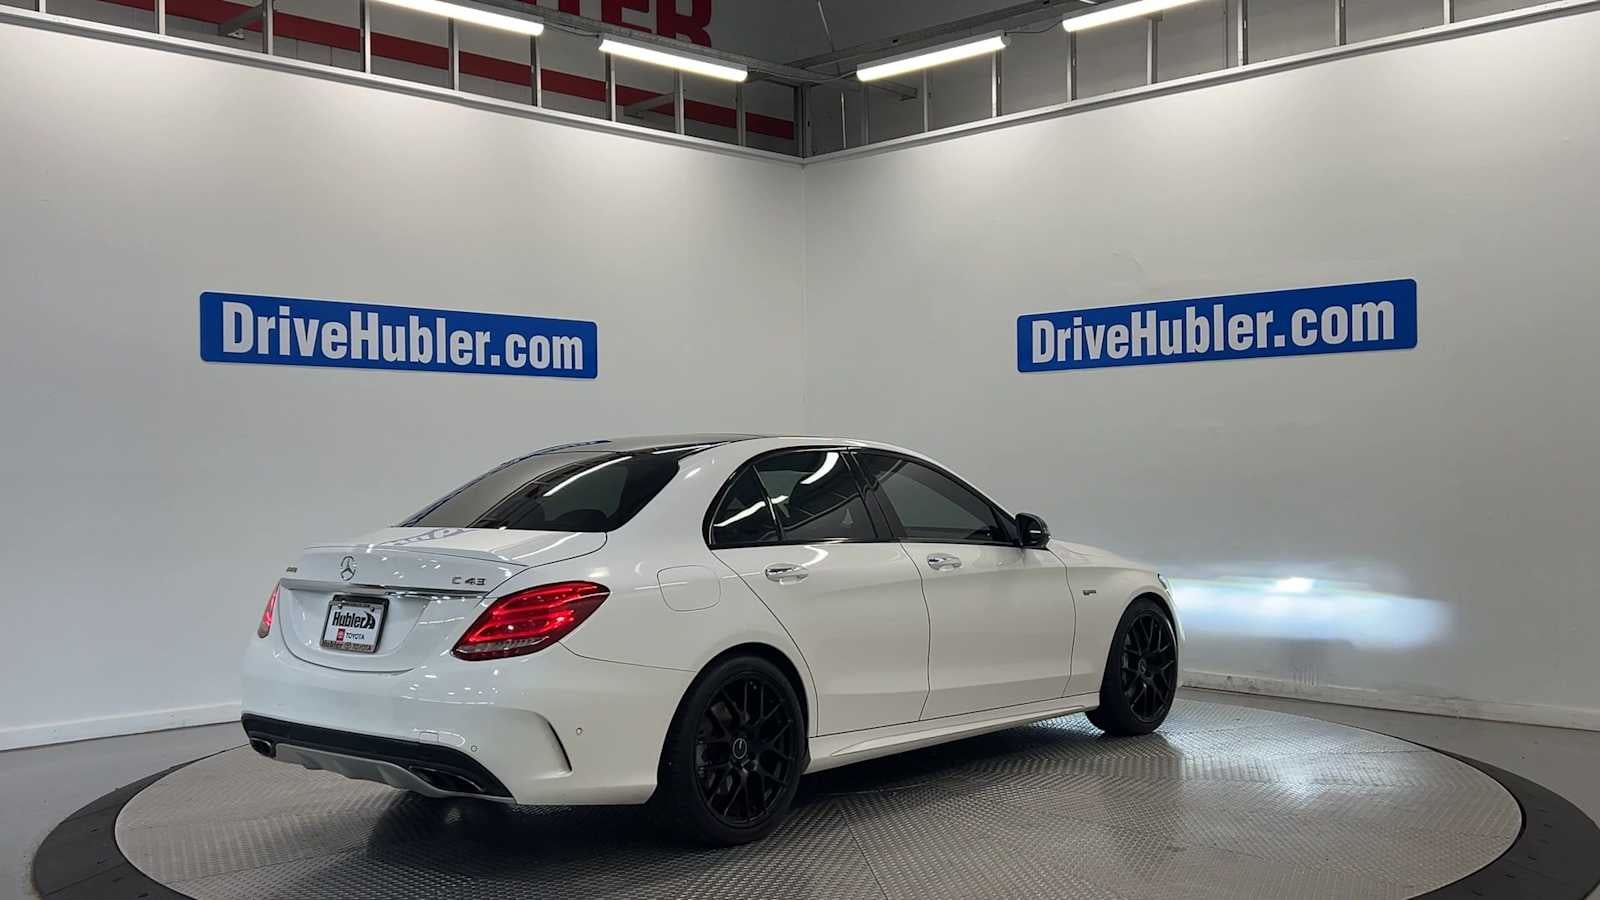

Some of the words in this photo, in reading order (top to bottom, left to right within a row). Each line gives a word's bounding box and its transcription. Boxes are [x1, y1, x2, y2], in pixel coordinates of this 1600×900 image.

[222, 302, 583, 370] DriveHubler.com
[1032, 301, 1394, 363] DriveHubler.com
[452, 576, 461, 584] C
[465, 577, 486, 586] 43
[332, 611, 367, 628] Hubler
[346, 632, 365, 640] TOYOTA
